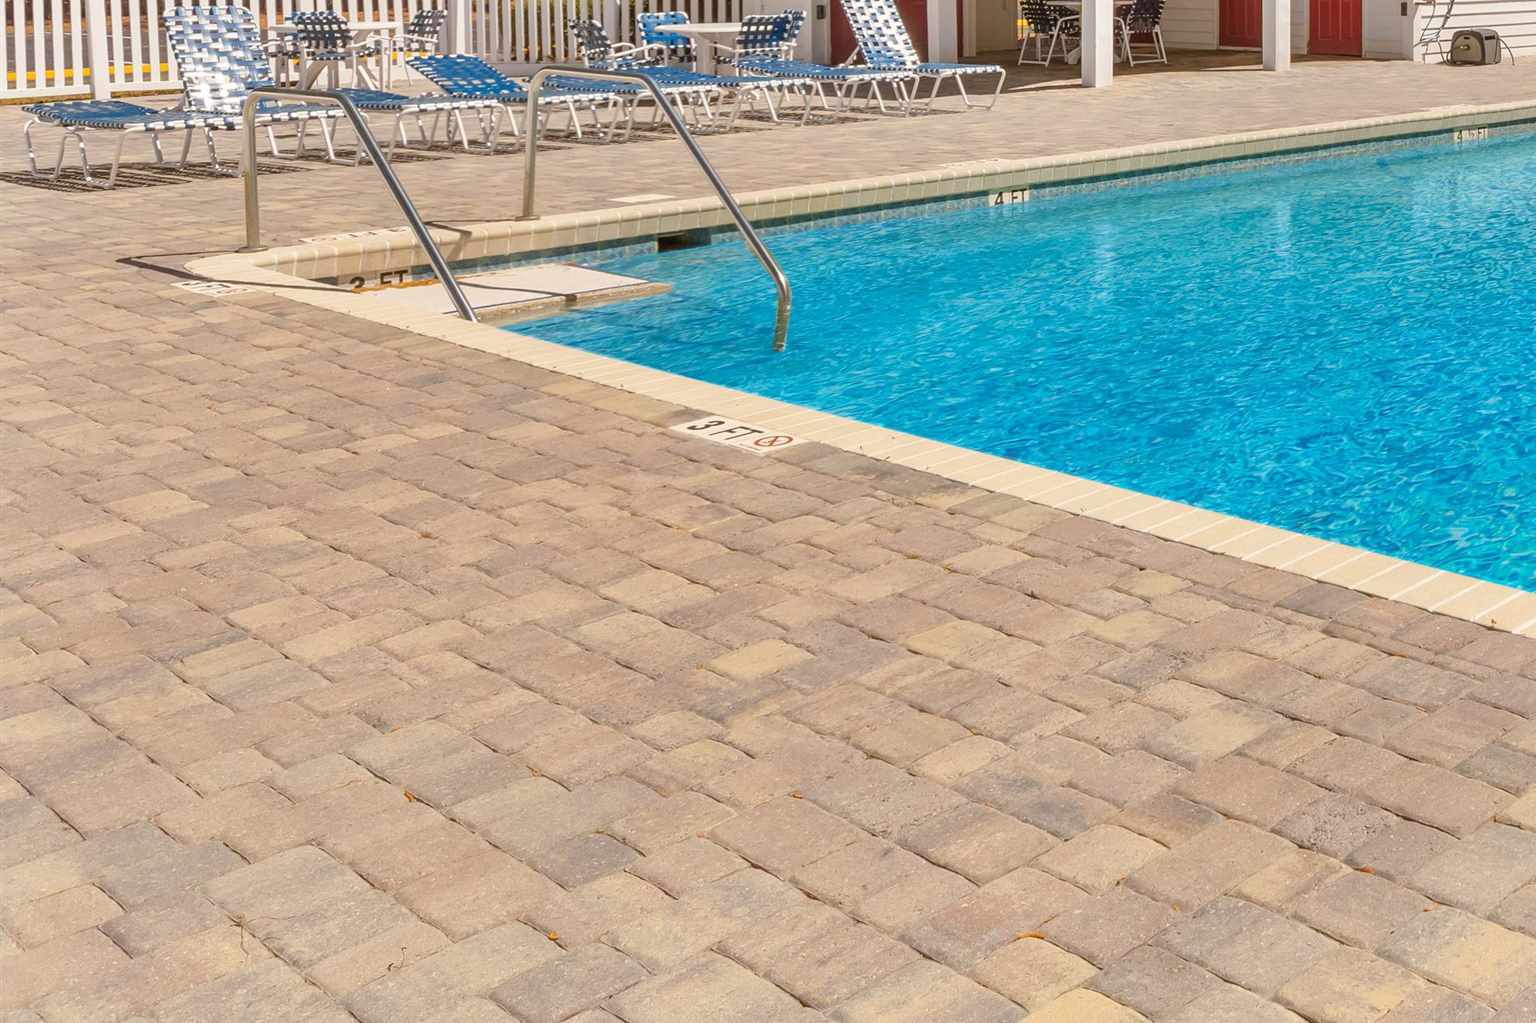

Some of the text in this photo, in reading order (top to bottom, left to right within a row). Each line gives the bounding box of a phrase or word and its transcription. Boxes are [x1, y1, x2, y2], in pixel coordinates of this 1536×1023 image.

[994, 188, 1027, 205] 4 FT
[687, 420, 764, 441] 3 FT
